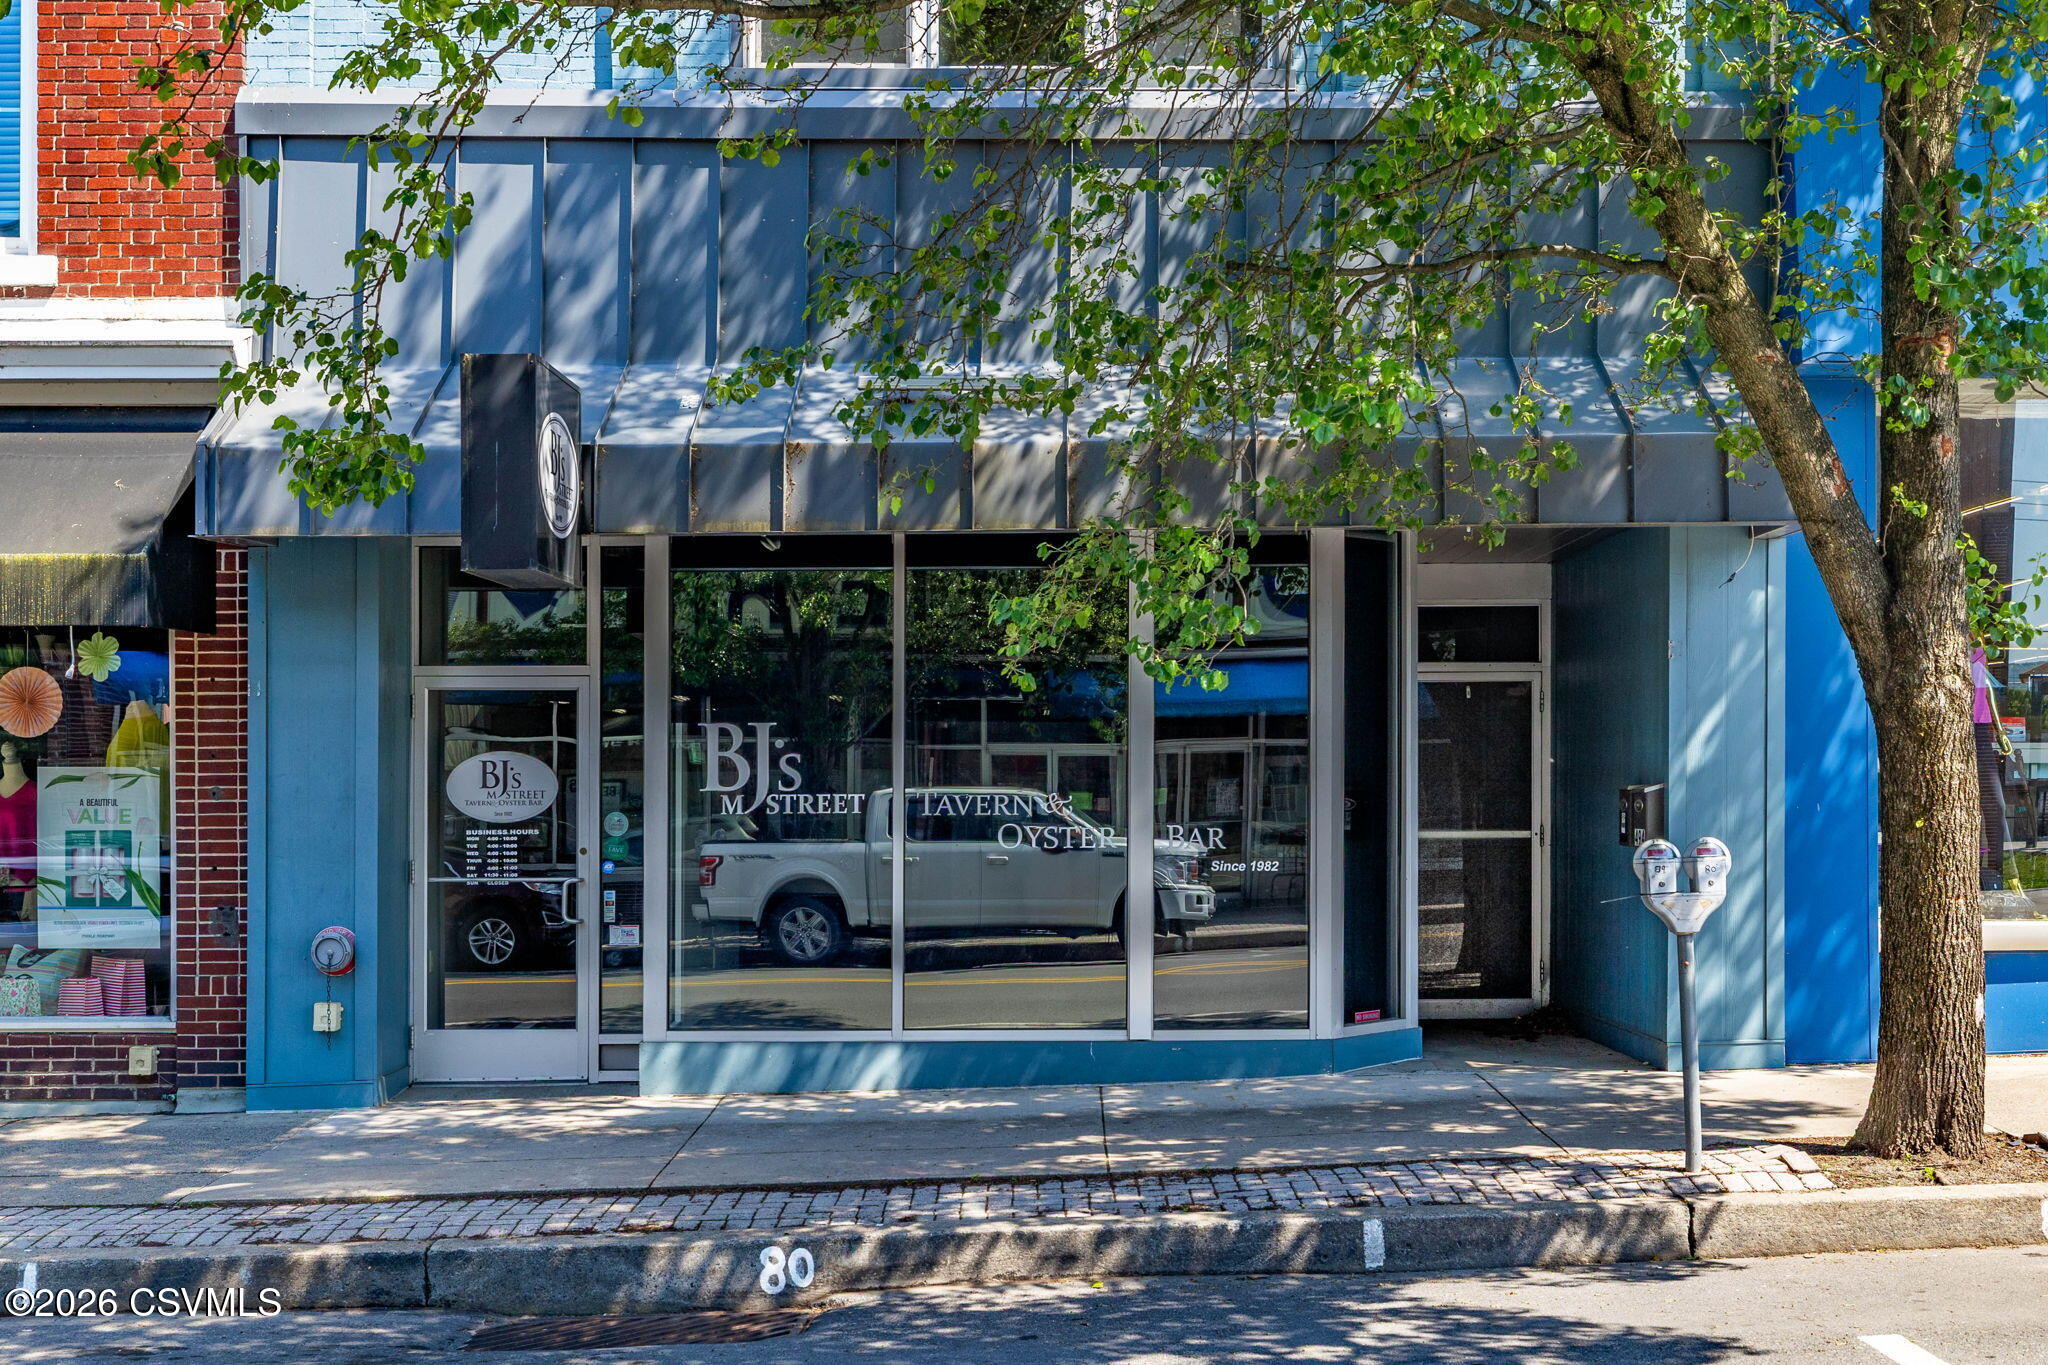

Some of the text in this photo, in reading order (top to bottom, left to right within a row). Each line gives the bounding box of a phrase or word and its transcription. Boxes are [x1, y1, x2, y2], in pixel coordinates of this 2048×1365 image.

[479, 760, 522, 798] BJ's
[698, 722, 802, 815] BJ's
[79, 799, 119, 807] A BEAUTIFUL
[486, 790, 546, 799] M STREET
[721, 794, 865, 815] M STREET
[1043, 792, 1073, 817] &
[67, 808, 132, 825] VALUE
[1210, 859, 1280, 872] Since 1982
[760, 1245, 815, 1295] 80
